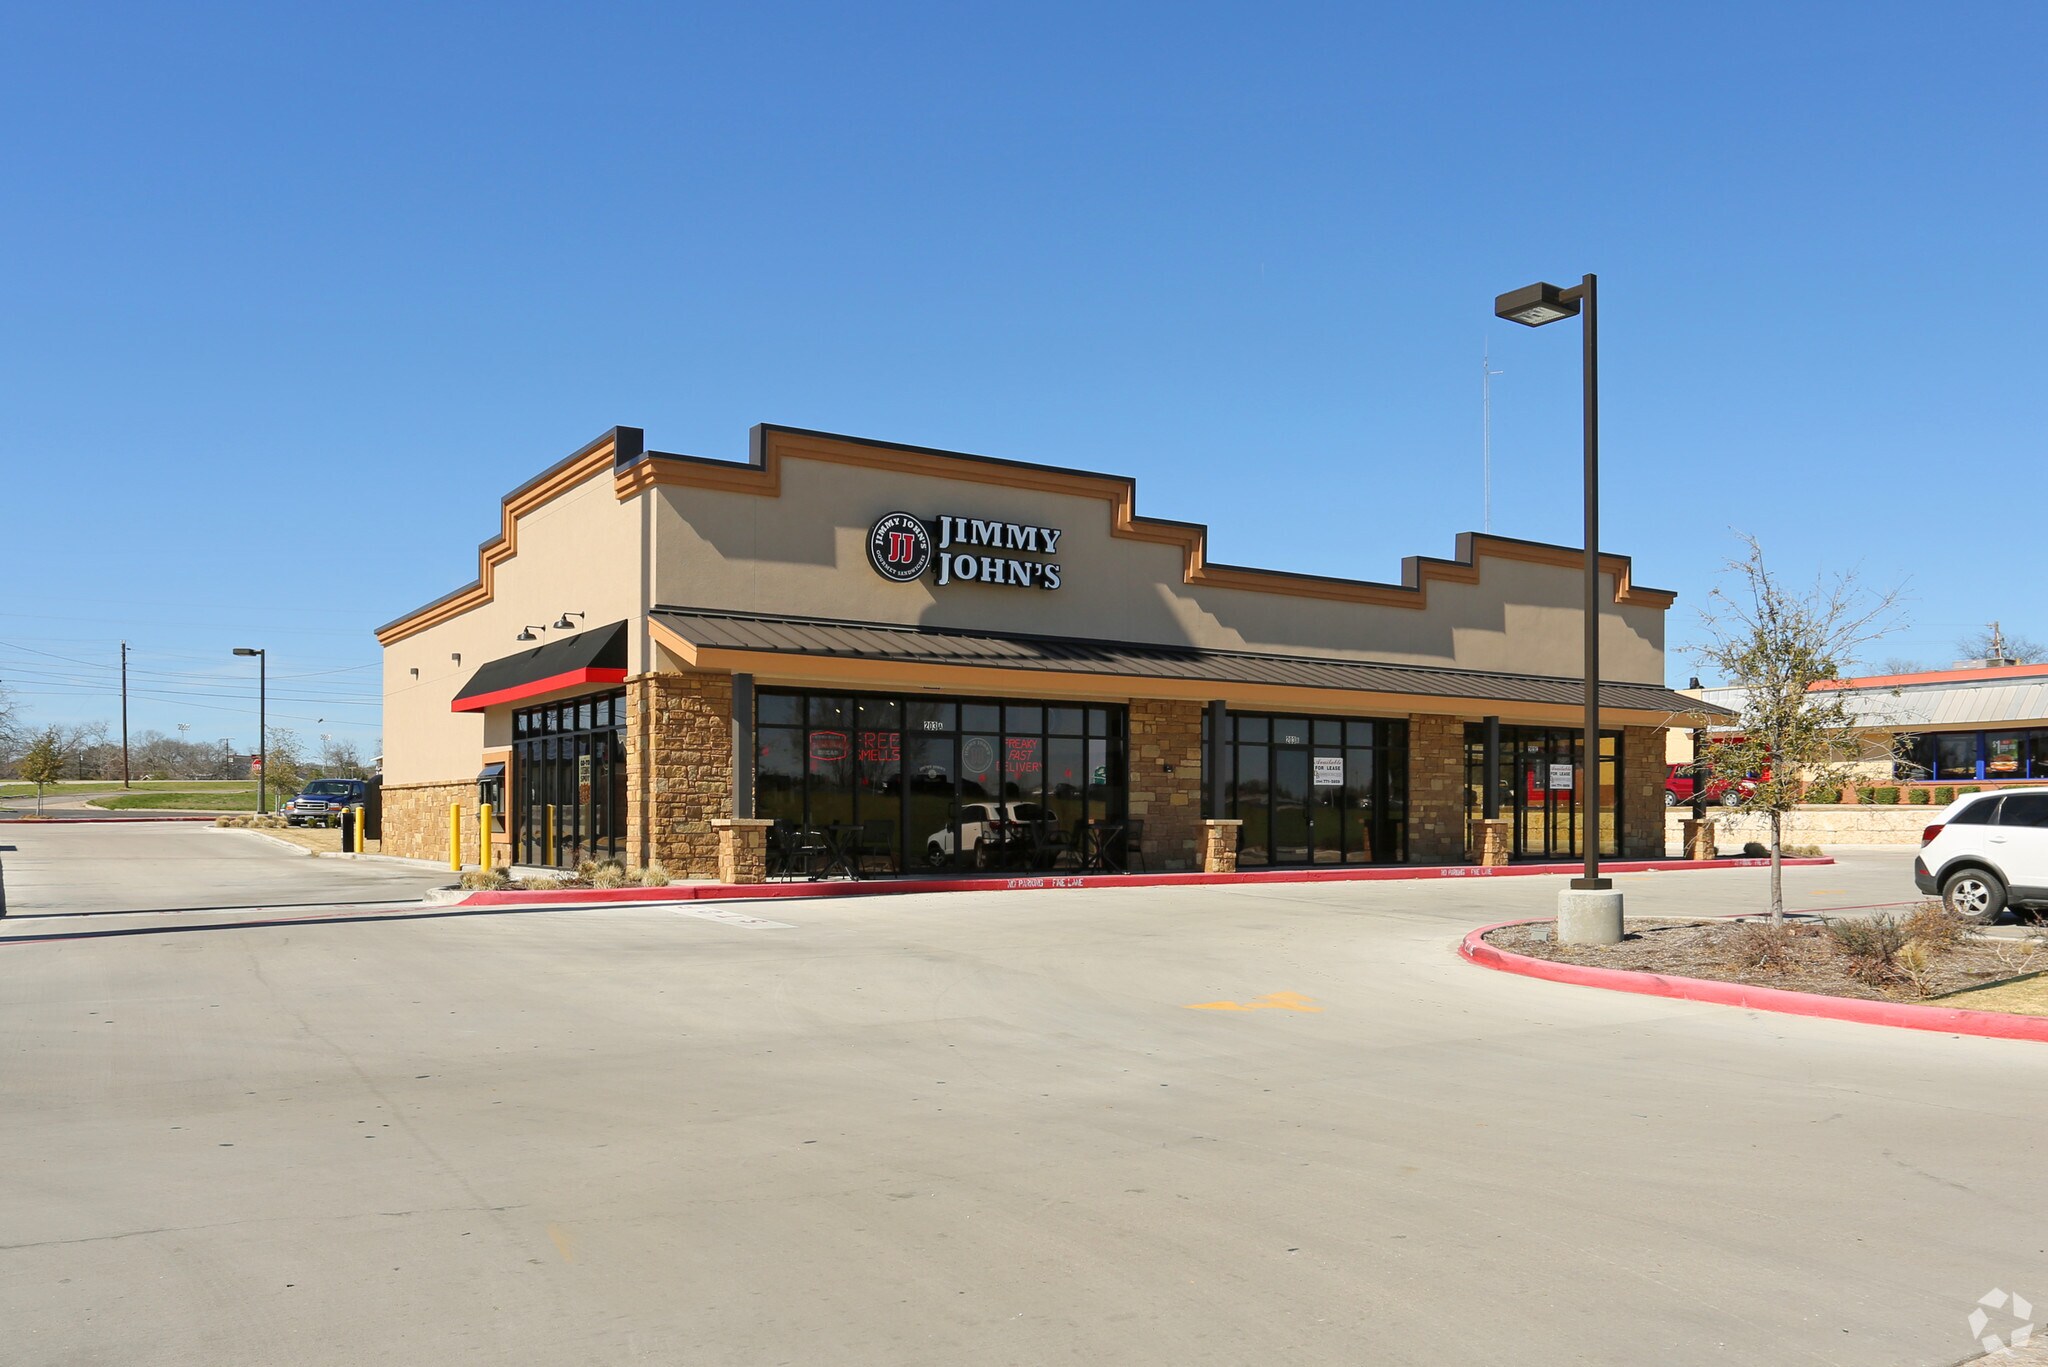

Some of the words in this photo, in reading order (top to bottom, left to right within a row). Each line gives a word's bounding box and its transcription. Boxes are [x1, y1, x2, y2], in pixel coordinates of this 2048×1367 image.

[875, 518, 900, 545] JIMMY
[902, 518, 927, 549] JOHN'S
[888, 532, 915, 563] JJ
[939, 515, 1061, 553] JIMMY
[876, 549, 897, 574] GOURMET
[938, 552, 1061, 590] JOHN'S
[1008, 750, 1034, 761] FAST
